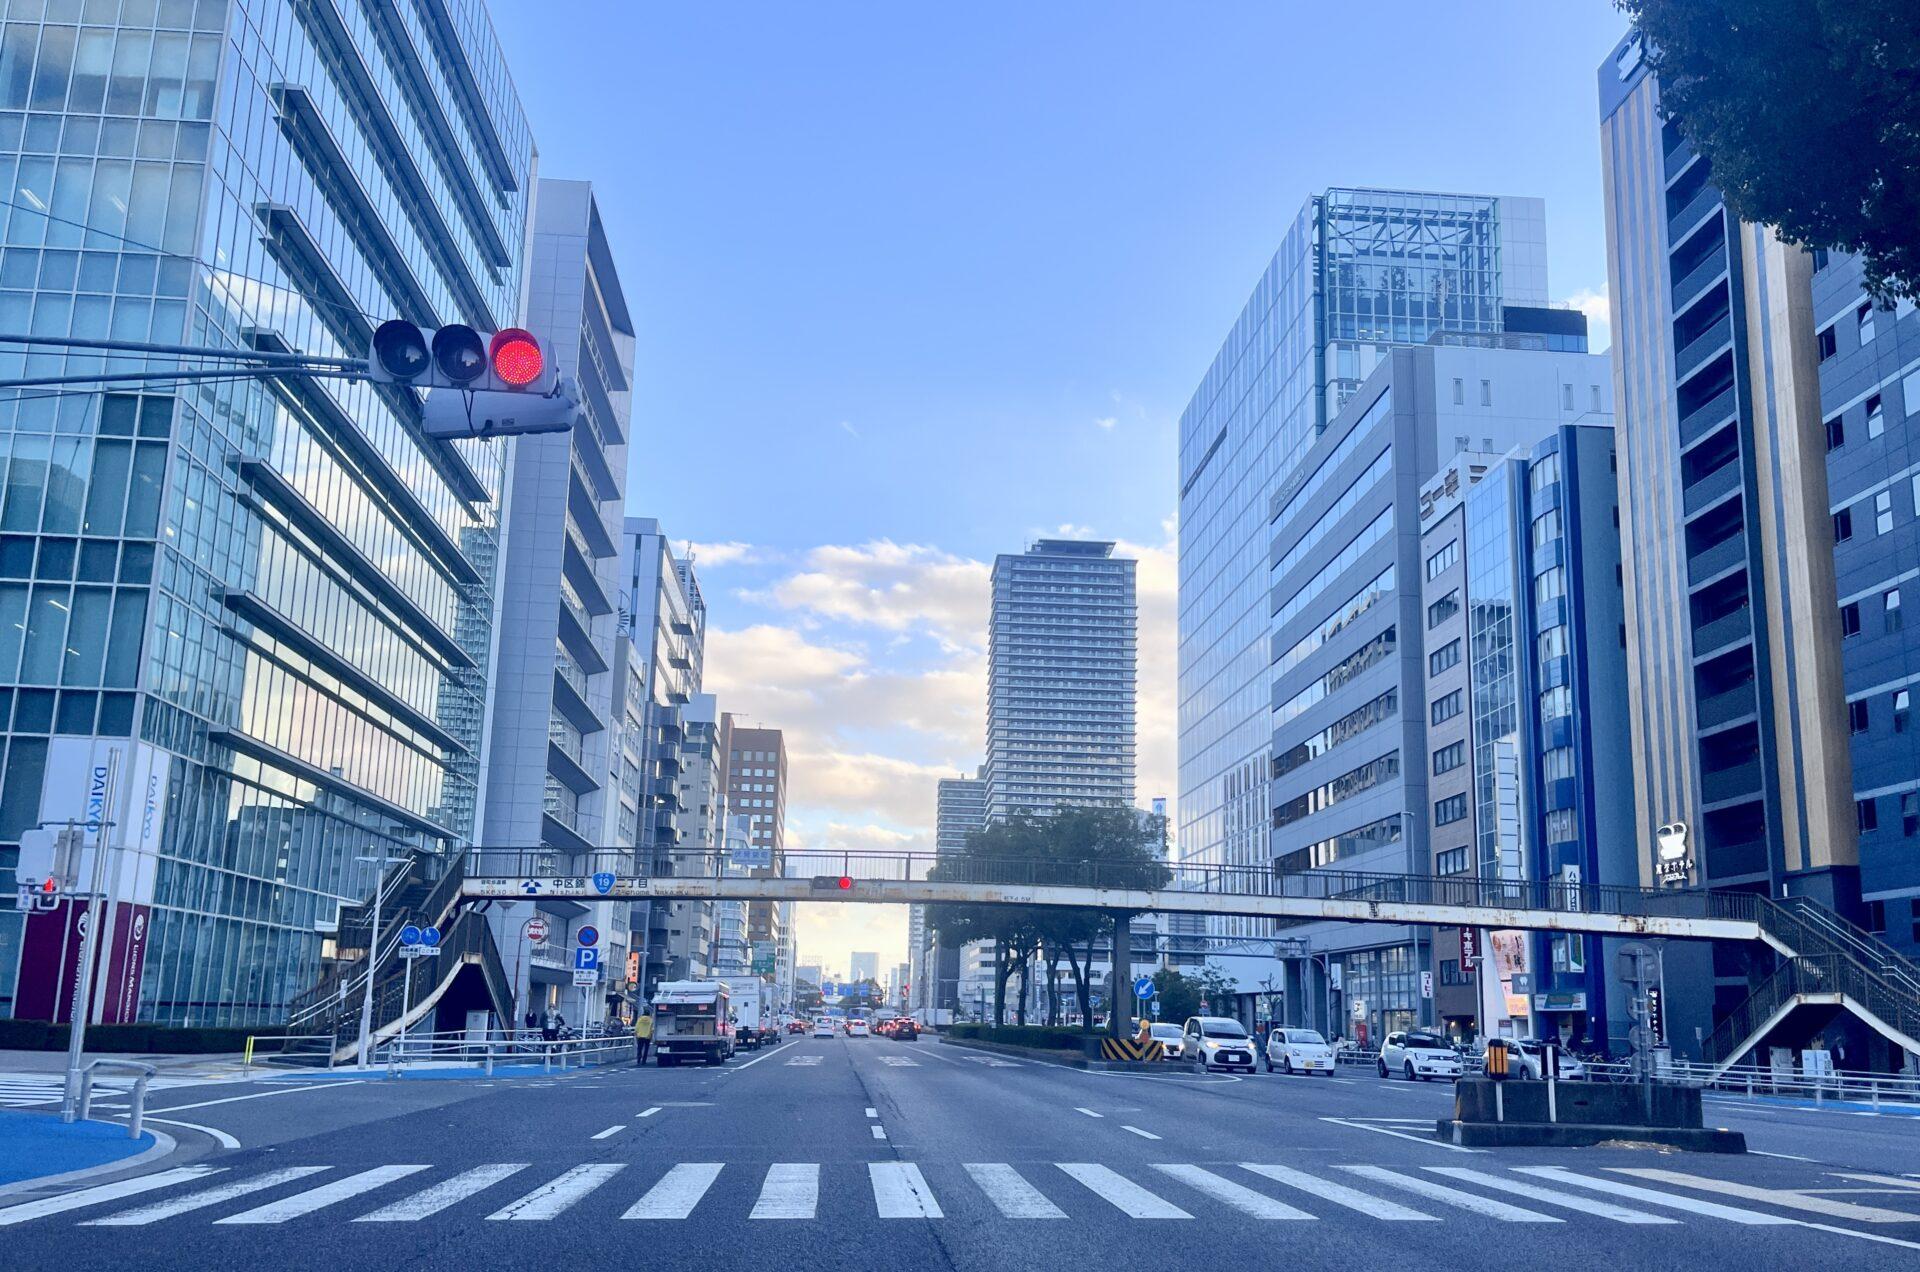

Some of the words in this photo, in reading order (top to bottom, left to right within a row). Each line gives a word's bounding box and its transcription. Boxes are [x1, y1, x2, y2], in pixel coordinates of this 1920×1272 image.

[87, 766, 107, 833] DAIKYO
[144, 775, 158, 839] DAIKYO
[598, 877, 610, 887] 19
[616, 878, 648, 889] 二丁目
[580, 949, 594, 967] P
